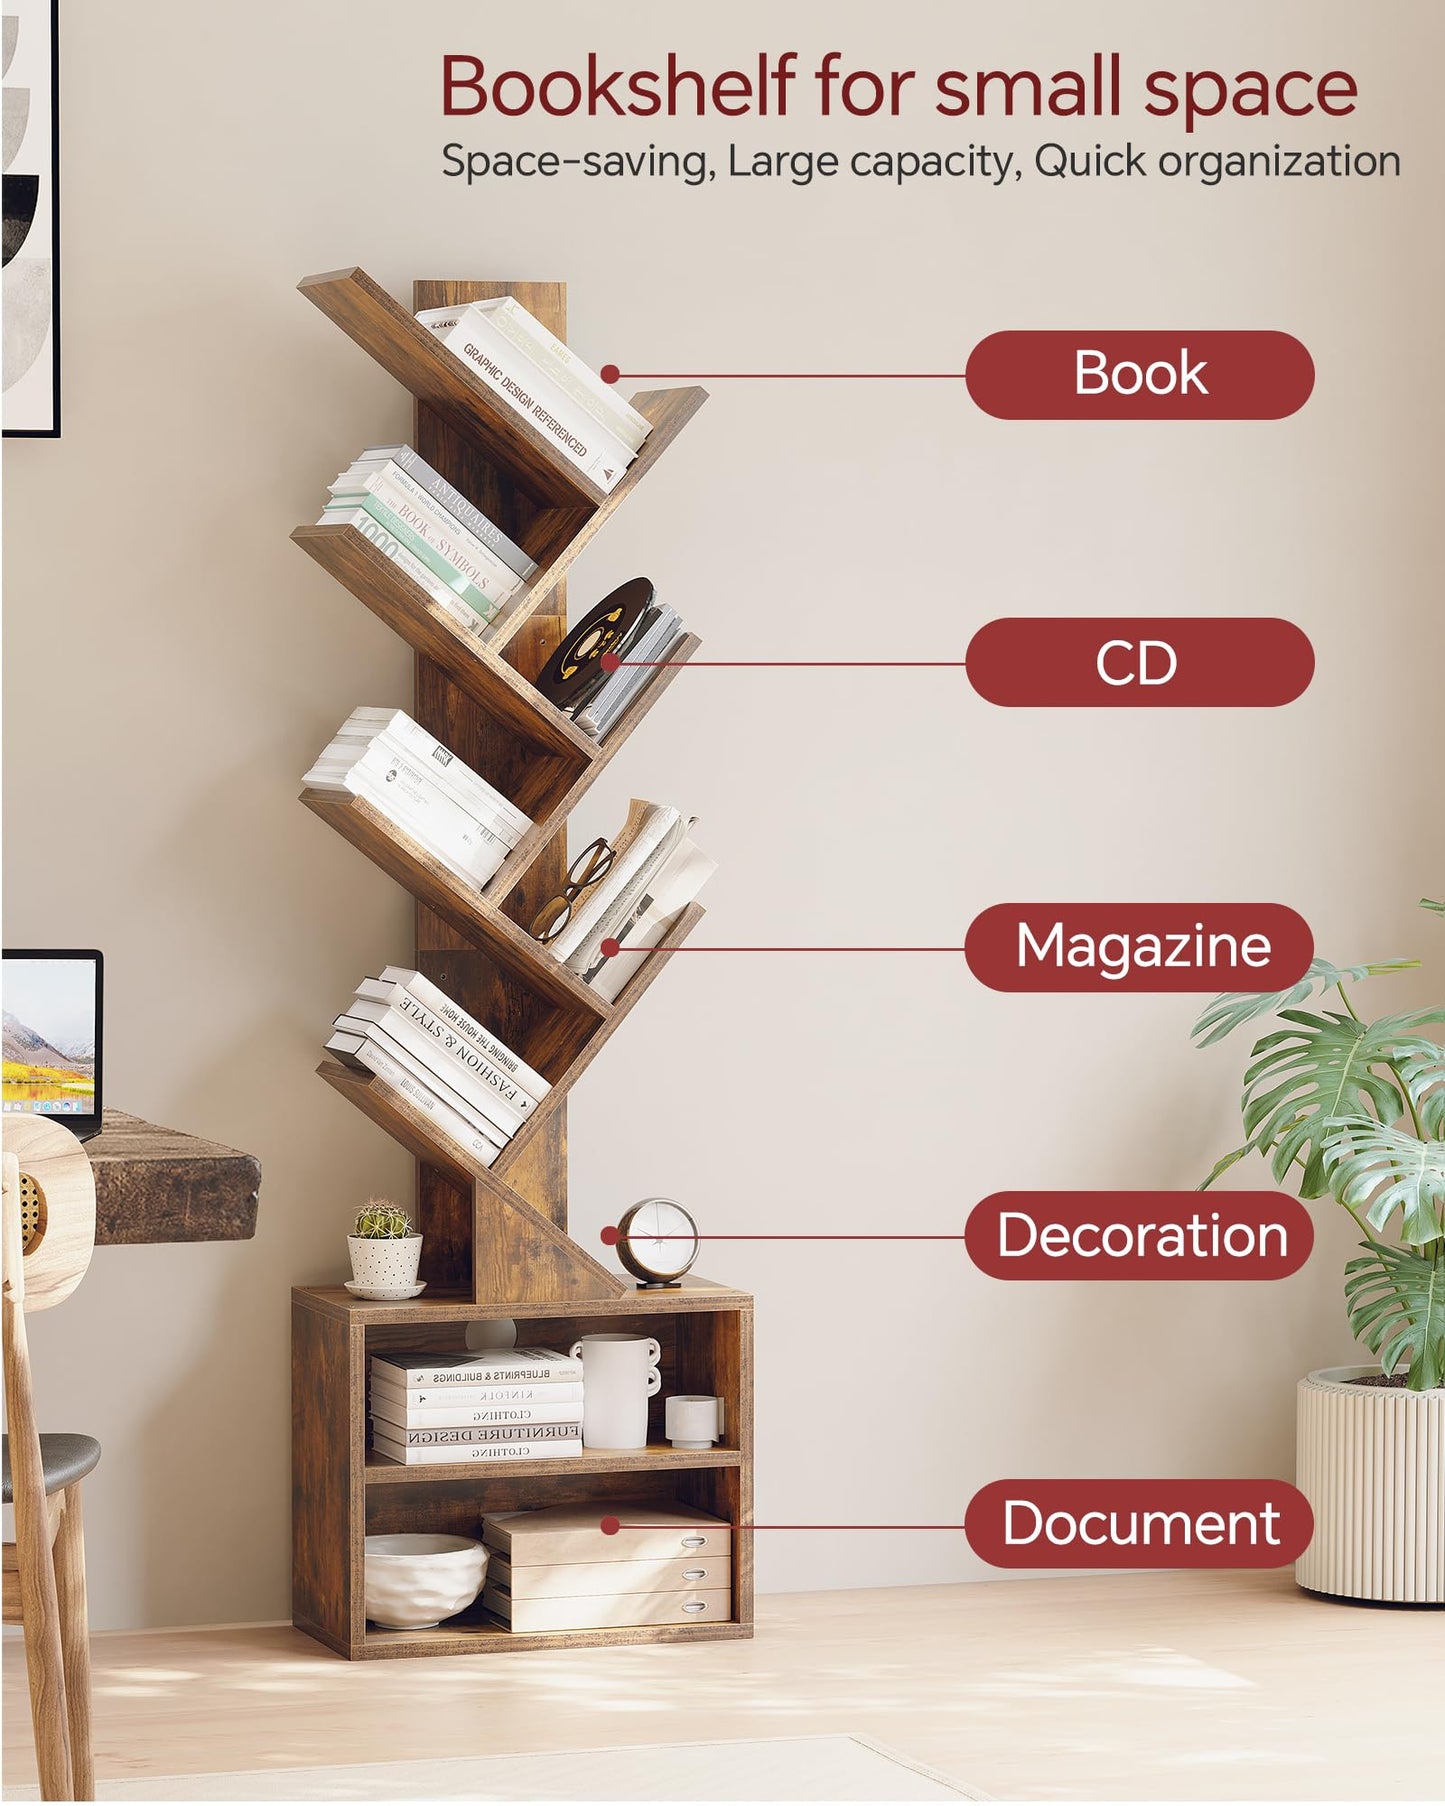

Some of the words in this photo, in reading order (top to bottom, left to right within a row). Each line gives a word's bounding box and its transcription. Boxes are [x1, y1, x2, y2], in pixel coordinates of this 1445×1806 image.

[463, 343, 503, 381] GRAPHIC
[501, 376, 535, 410] DESIGN
[531, 404, 588, 458] REFERENCED
[392, 470, 415, 494] FORMULA
[417, 494, 436, 512] WORLD
[433, 508, 462, 536] CHAMPIONS
[432, 478, 503, 543] ANTIQUAIRES
[358, 516, 400, 559] 1000
[398, 504, 429, 537] BOOK
[435, 538, 490, 589] SYMBOLS
[400, 996, 445, 1038] STYLE
[440, 1002, 459, 1022] HOME
[456, 1016, 477, 1040] HOUSE
[445, 1033, 458, 1048] &
[476, 1033, 491, 1050] THE
[489, 1043, 518, 1072] BRINGING
[455, 1045, 518, 1101] FASHION
[400, 1078, 416, 1094] LOUIS
[412, 1088, 436, 1111] SULLIVAN
